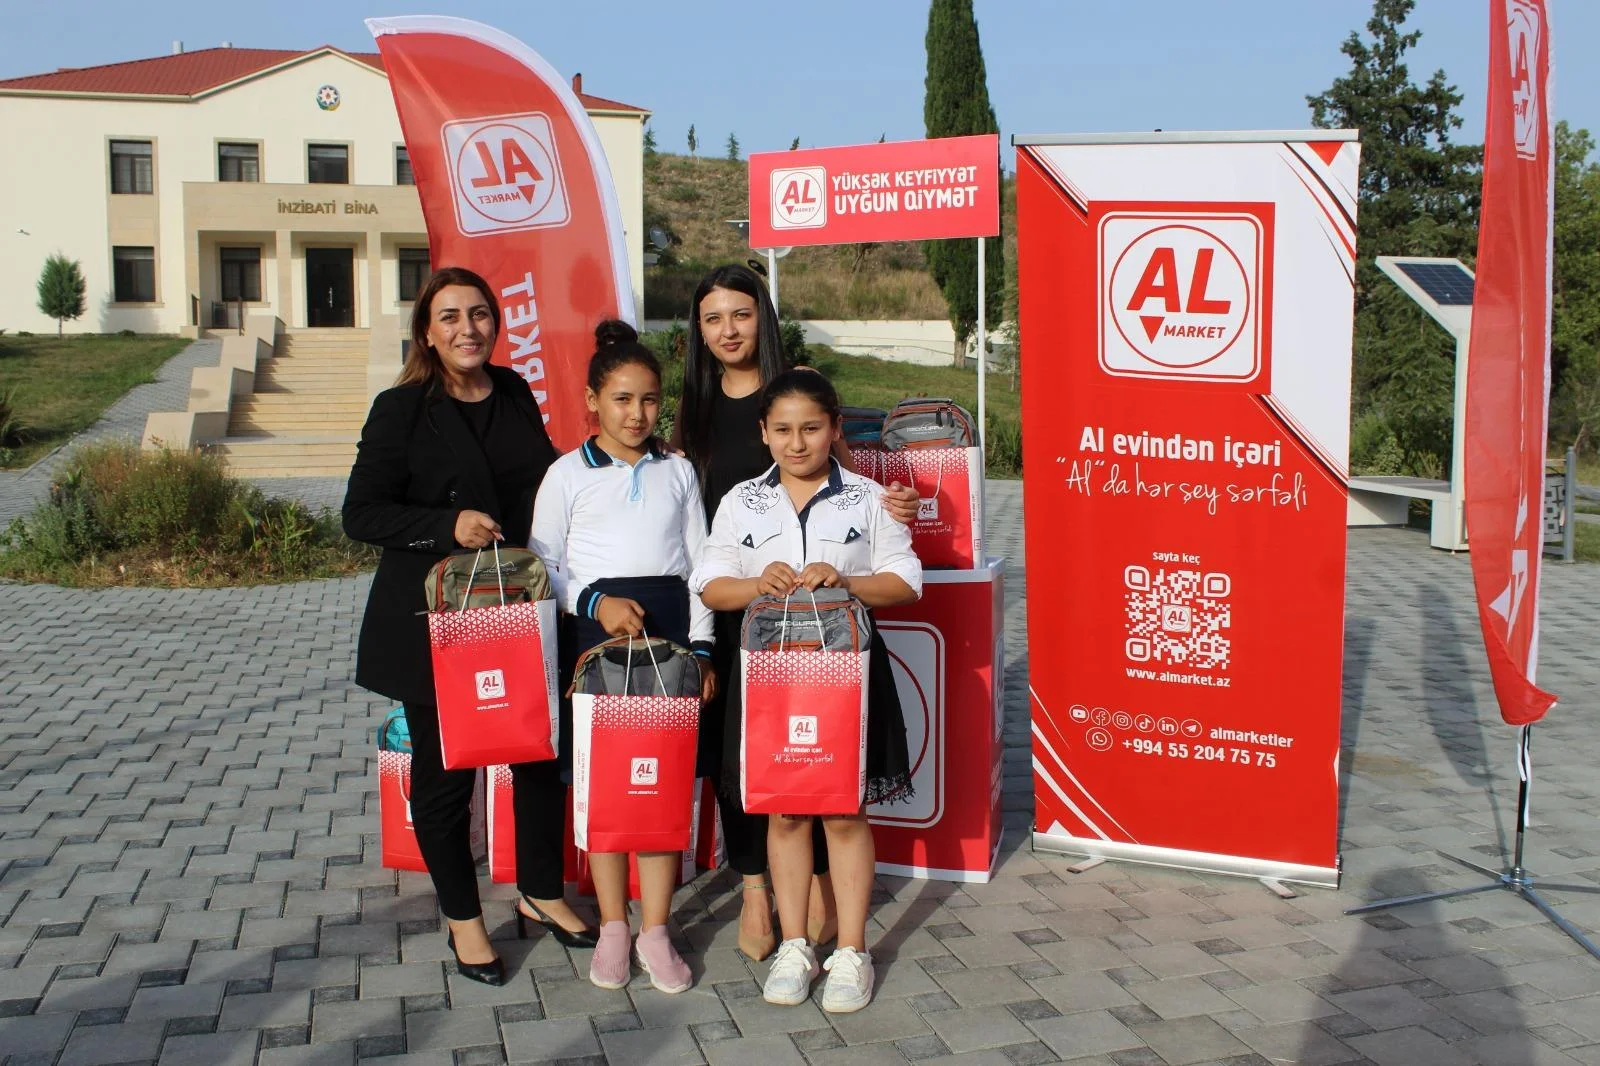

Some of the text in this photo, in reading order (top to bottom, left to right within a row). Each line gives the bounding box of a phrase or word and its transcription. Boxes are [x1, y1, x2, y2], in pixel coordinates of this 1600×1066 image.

[832, 166, 977, 191] YÜKSƏK KEYFİYYƏT
[781, 179, 816, 205] AL
[834, 186, 978, 215] UYĞUN QİYMƏT
[278, 199, 379, 214] İNZİBATİ BİNA
[1126, 247, 1232, 315] AL
[1163, 324, 1226, 339] MARKET
[1079, 426, 1281, 469] Al evindən içəri
[1135, 462, 1176, 498] hər
[1179, 482, 1222, 516] şey
[1226, 471, 1309, 512] sərfəli
[921, 503, 935, 511] AL
[1152, 551, 1201, 565] sayta keç
[1168, 610, 1187, 622] AL
[482, 675, 500, 688] AL
[1126, 667, 1231, 688] www.almarket.az
[794, 721, 812, 733] AL
[1209, 726, 1294, 748] almarketler
[1122, 738, 1276, 768] +994 55 204 75 75
[636, 763, 653, 774] AL
